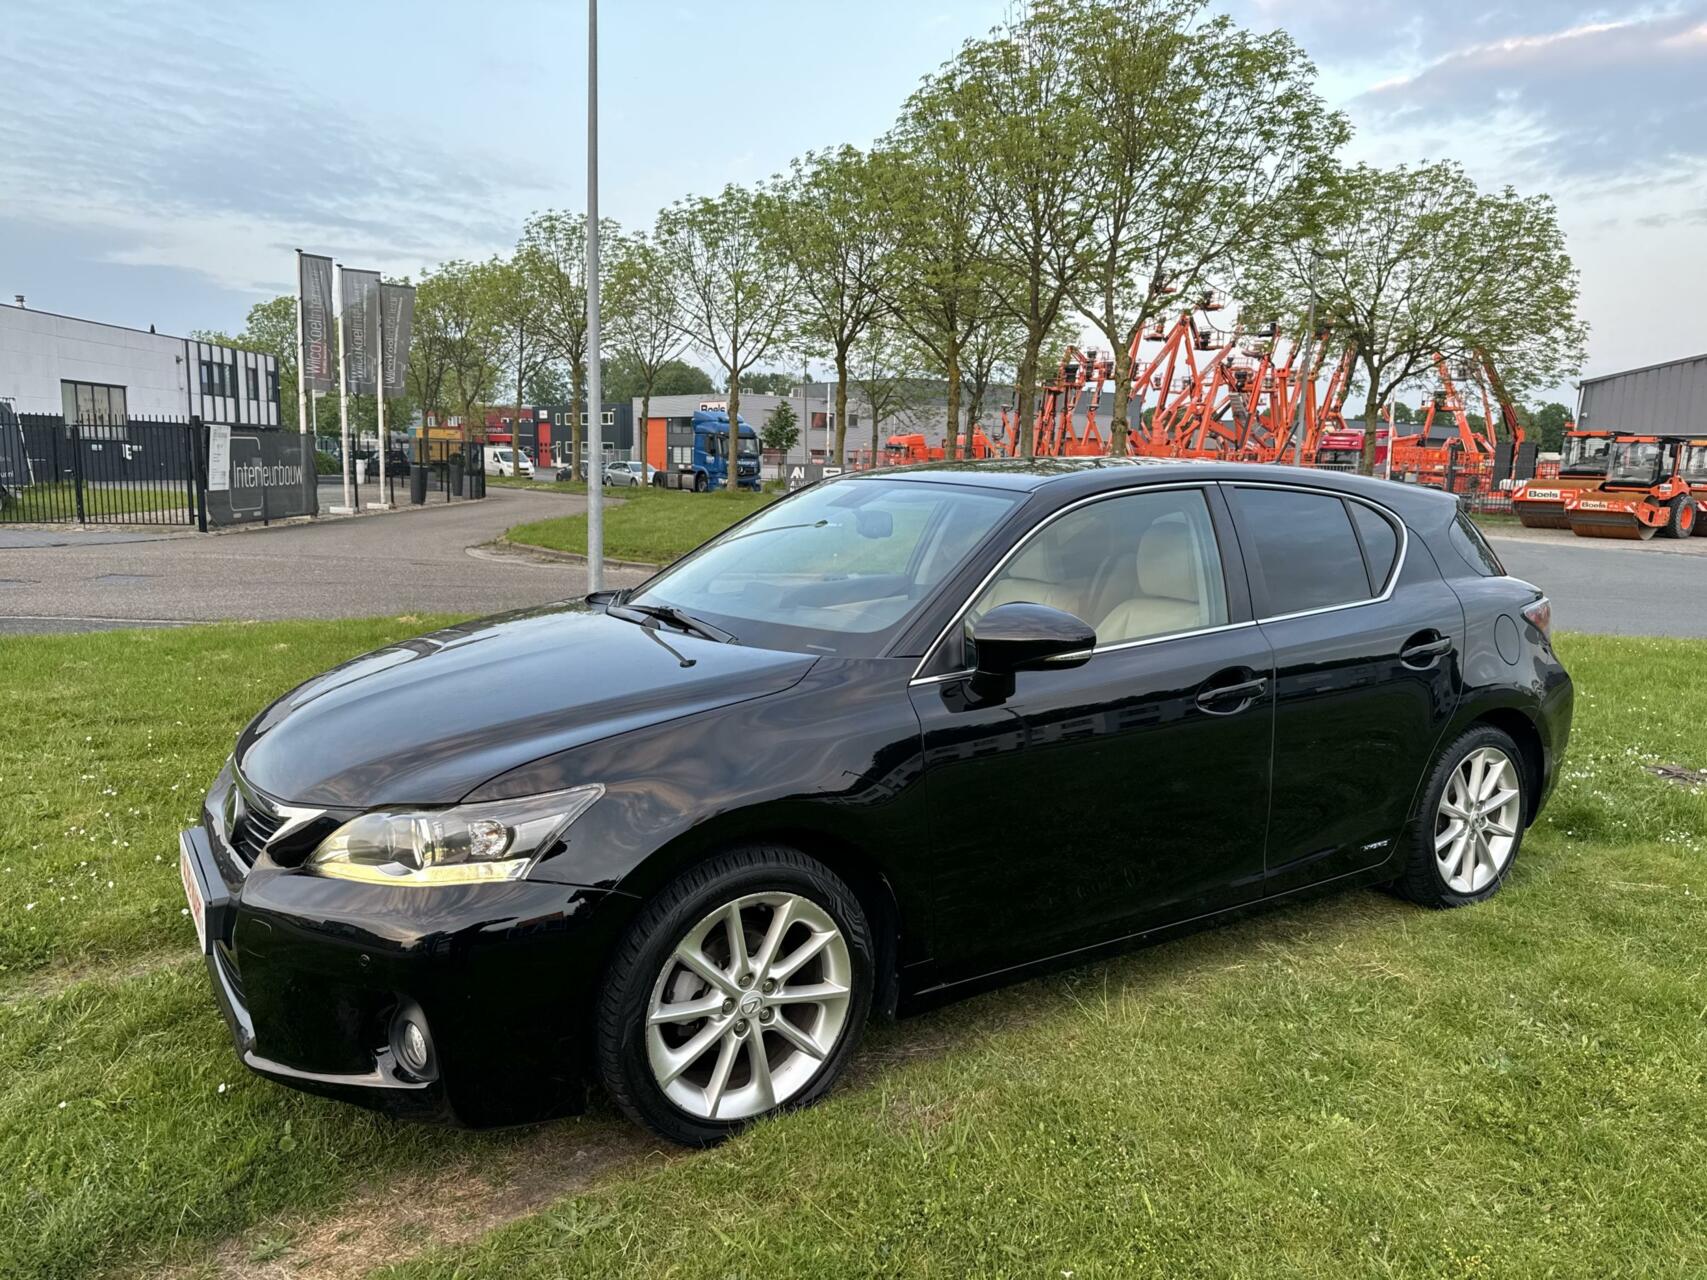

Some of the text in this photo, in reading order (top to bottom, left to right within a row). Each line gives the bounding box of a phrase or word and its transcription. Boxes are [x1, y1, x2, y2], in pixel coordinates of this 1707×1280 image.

[233, 459, 303, 488] Interieurbouw
[1528, 490, 1558, 498] Boels
[1581, 501, 1606, 509] Boels
